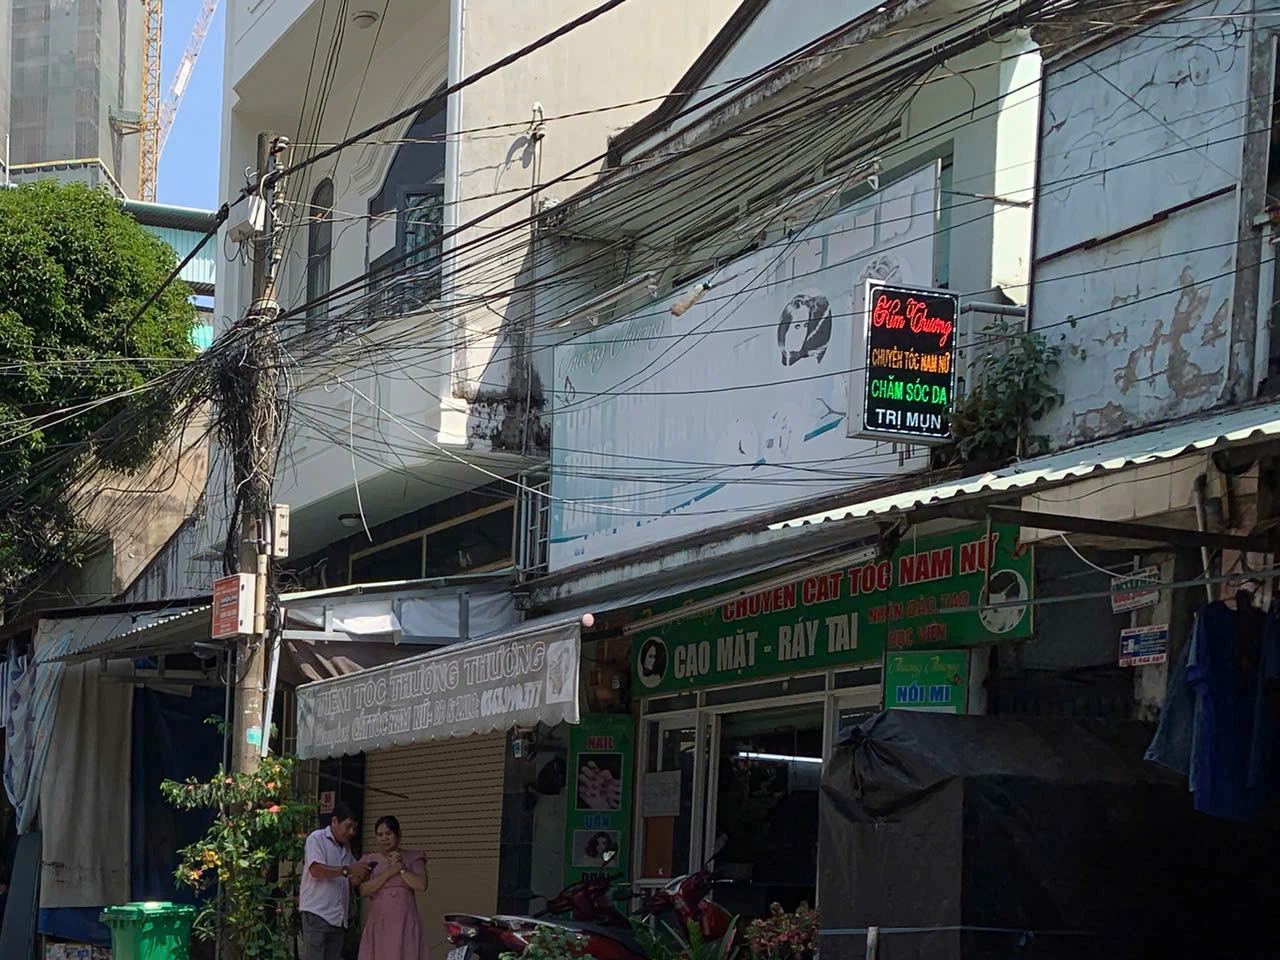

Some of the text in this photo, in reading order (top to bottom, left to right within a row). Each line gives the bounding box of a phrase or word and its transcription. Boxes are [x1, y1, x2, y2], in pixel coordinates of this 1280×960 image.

[904, 347, 920, 370] TÓC
[920, 352, 937, 373] NAM
[871, 375, 948, 405] CHĂM SÓC DA
[875, 408, 942, 431] TRỊ MỤN
[848, 559, 894, 597] TÓC
[898, 546, 954, 587] NAM
[673, 643, 711, 684] CẠO
[716, 629, 759, 675] MẶT
[778, 617, 820, 662] RÁY
[824, 612, 859, 654] TAI
[353, 676, 387, 709] TÓC
[390, 660, 460, 702] THƯƠNG
[463, 641, 546, 686] THƯƠNG
[928, 684, 952, 703] MI
[587, 735, 614, 750] NAIL
